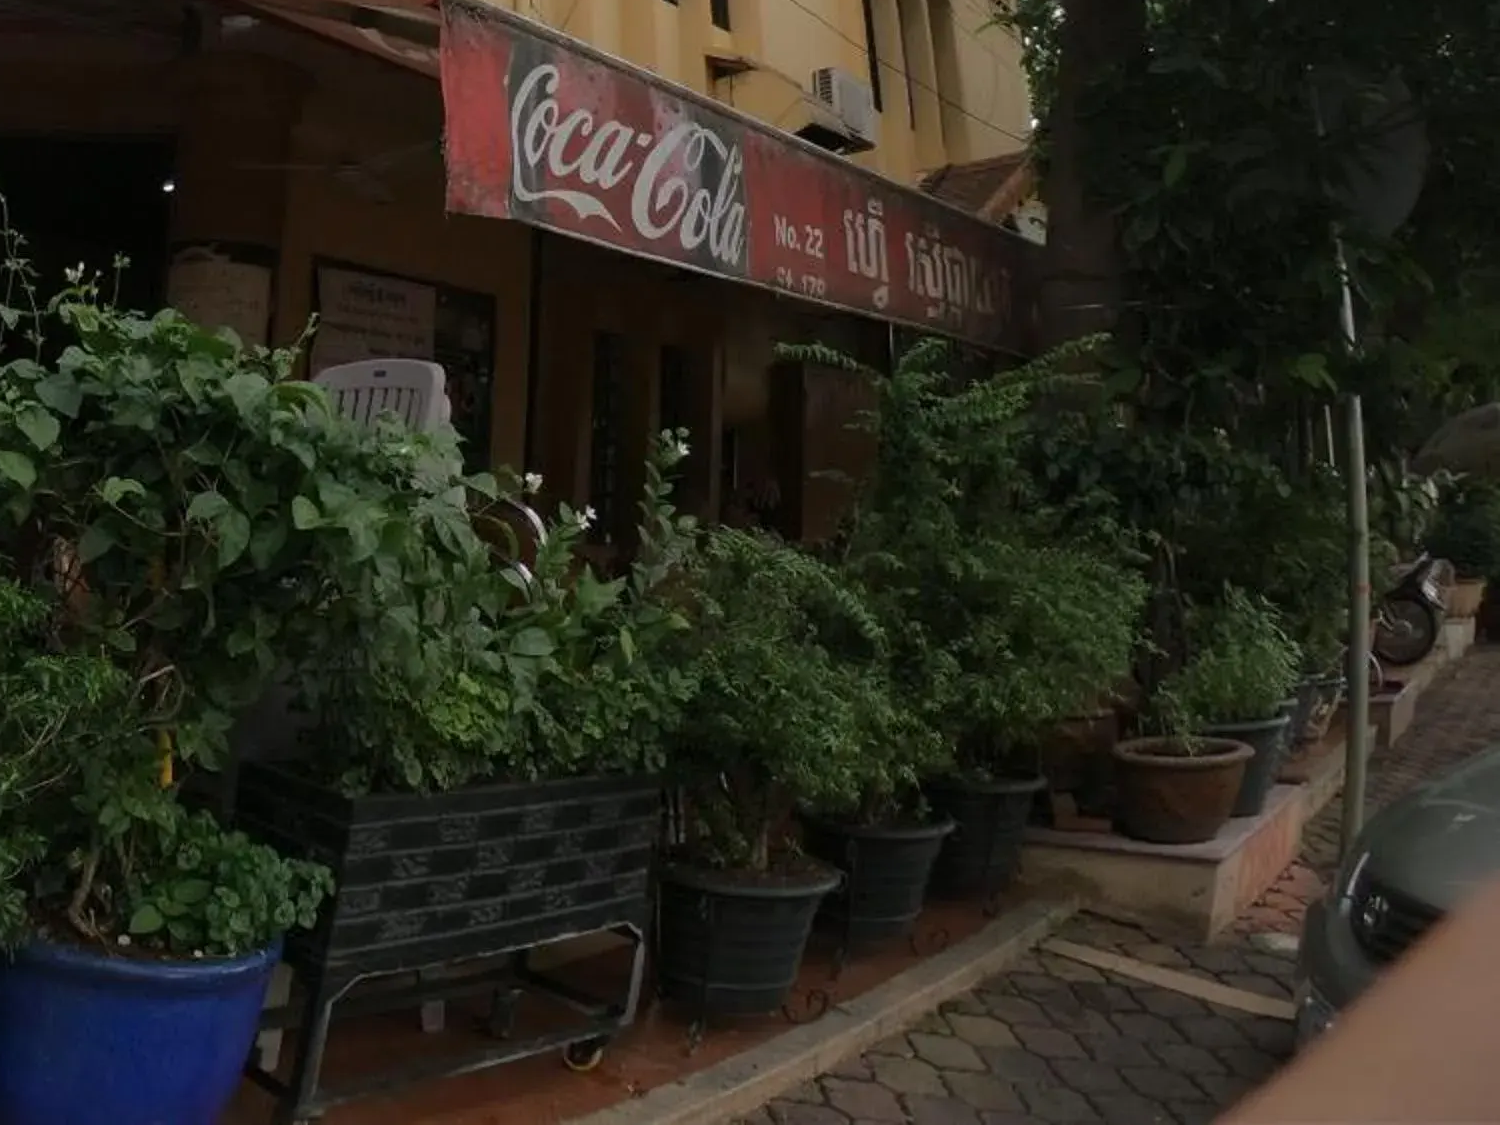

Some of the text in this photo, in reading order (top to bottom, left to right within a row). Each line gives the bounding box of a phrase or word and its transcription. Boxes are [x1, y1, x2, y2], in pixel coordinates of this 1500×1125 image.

[511, 63, 746, 268] Coca-Cola
[772, 213, 825, 260] No. 22
